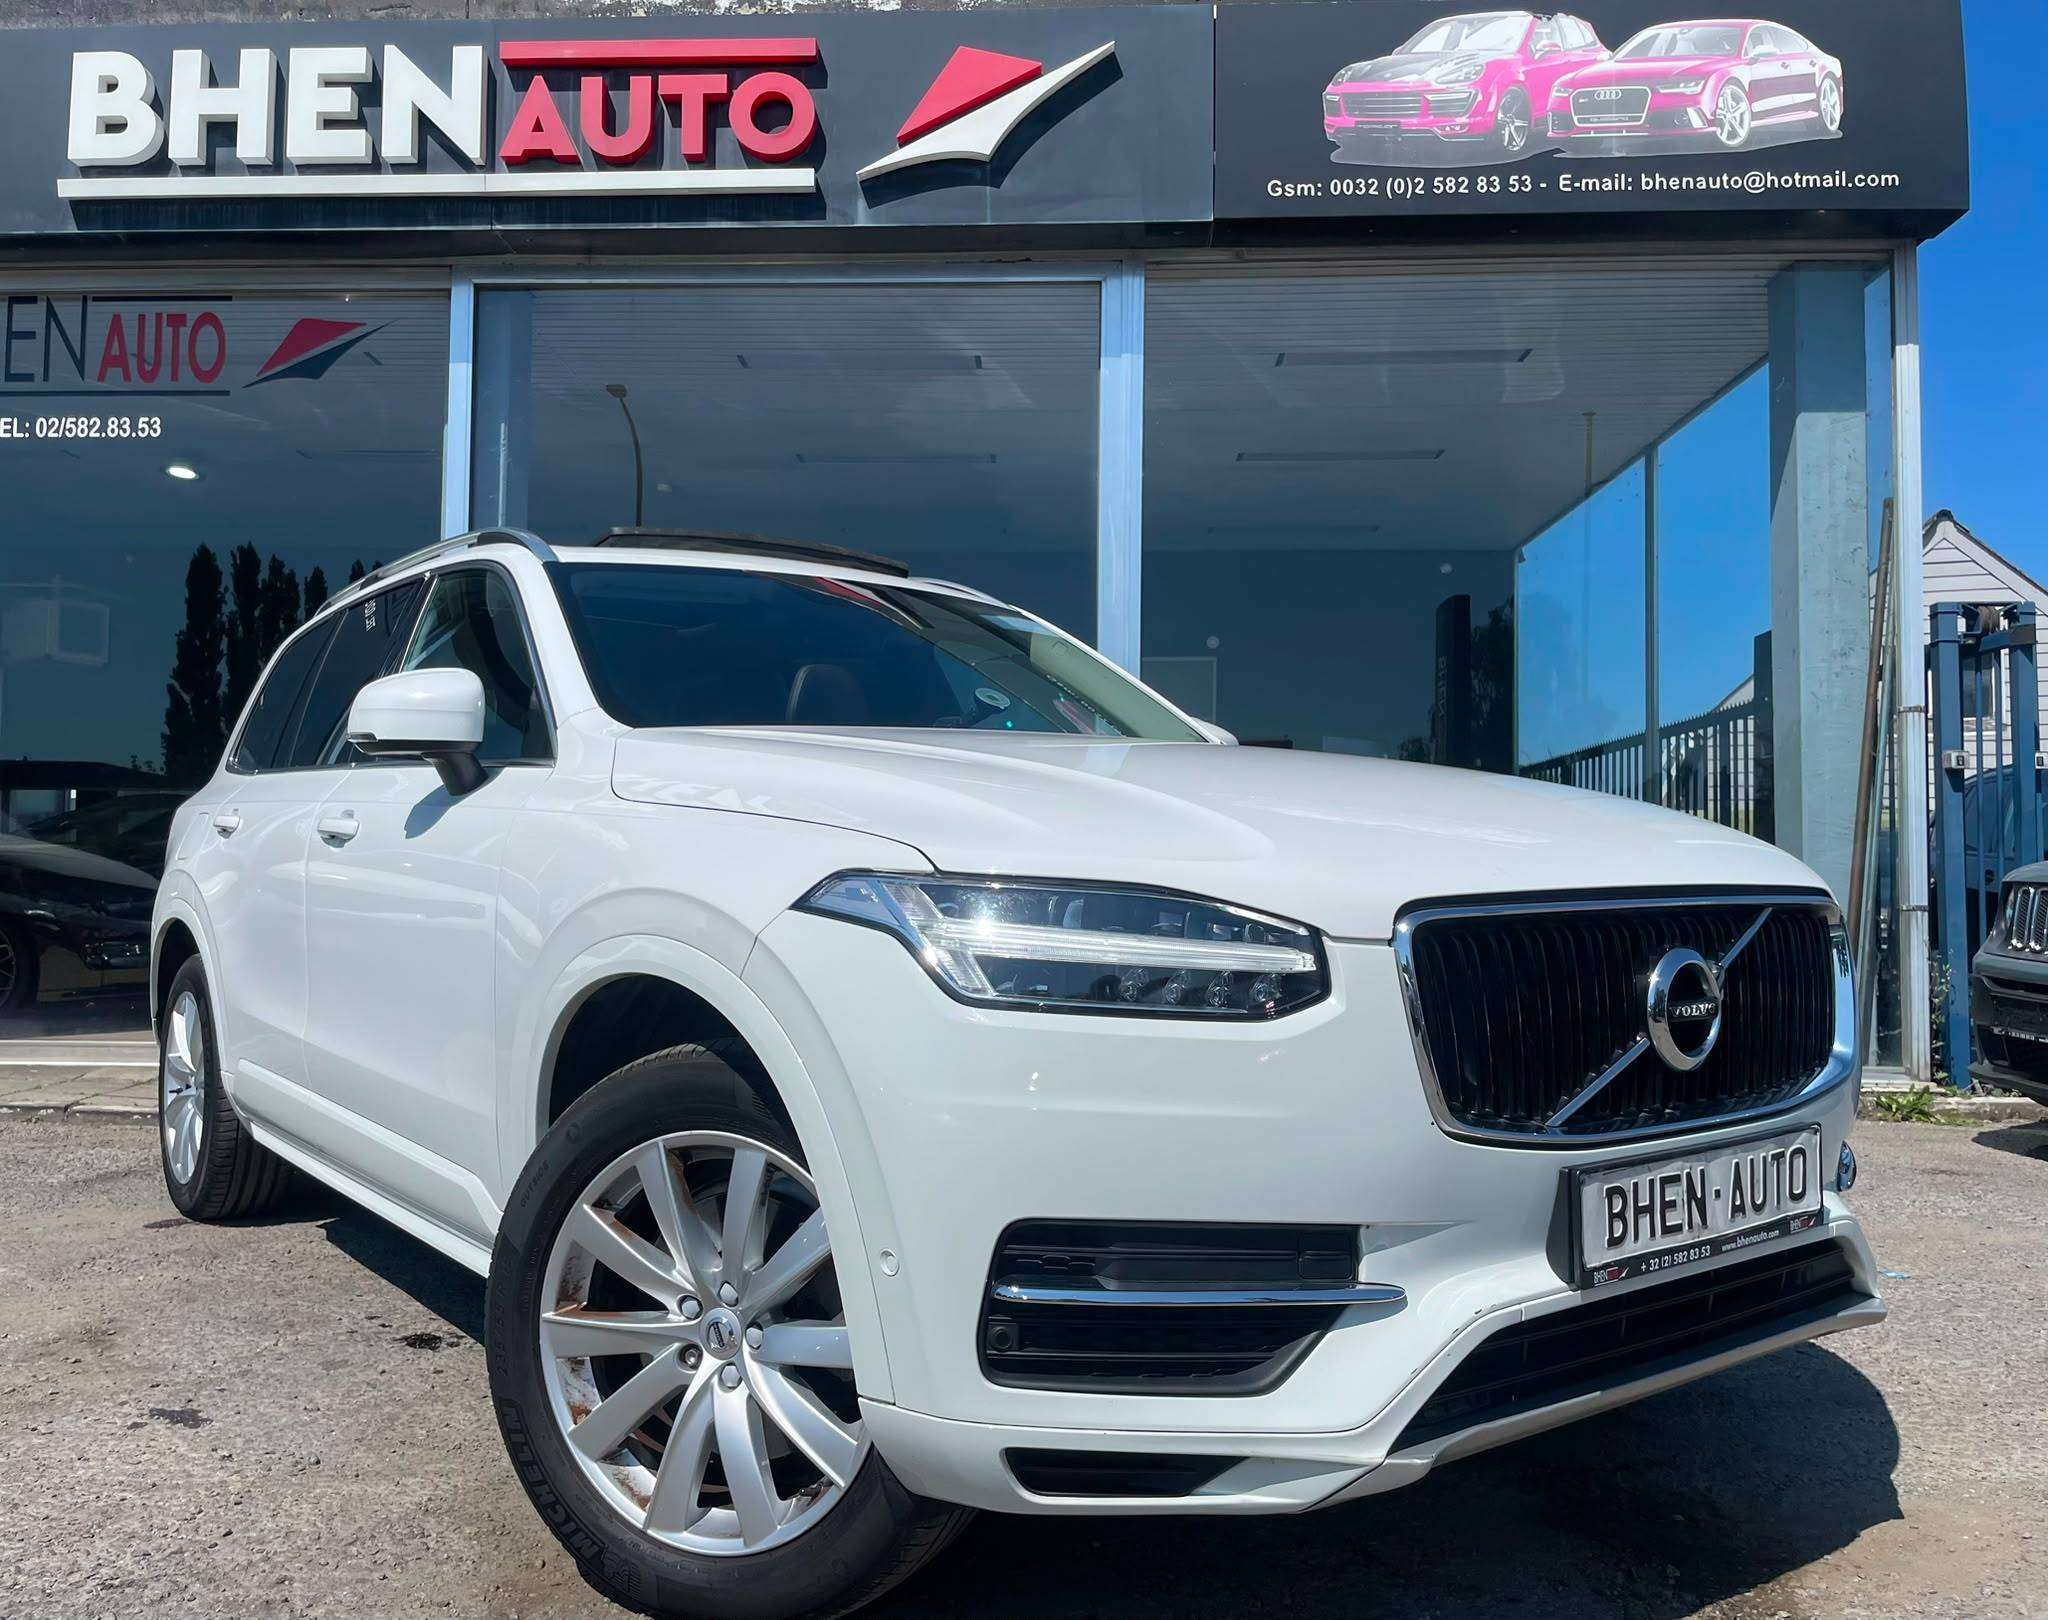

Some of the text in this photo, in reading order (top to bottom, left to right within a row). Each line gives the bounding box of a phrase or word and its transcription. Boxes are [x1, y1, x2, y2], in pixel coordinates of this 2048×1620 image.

[68, 45, 816, 166] BHEN AUTO
[1266, 179, 1323, 197] Gsm:
[1329, 178, 1379, 196] 0032
[1386, 177, 1426, 199] (0)2
[1432, 176, 1470, 194] 582
[1476, 175, 1501, 193] 83
[1508, 175, 1532, 193] 53
[1558, 173, 1634, 192] E-mail:
[1641, 170, 1900, 194] bhenauto@hotmail.com
[97, 311, 227, 384] AUTO
[35, 417, 162, 438] 02/582.83.53
[1649, 1258, 1660, 1271] 32
[1673, 1250, 1688, 1265] 582
[1689, 1247, 1700, 1260] 83
[1700, 1245, 1711, 1258] 53
